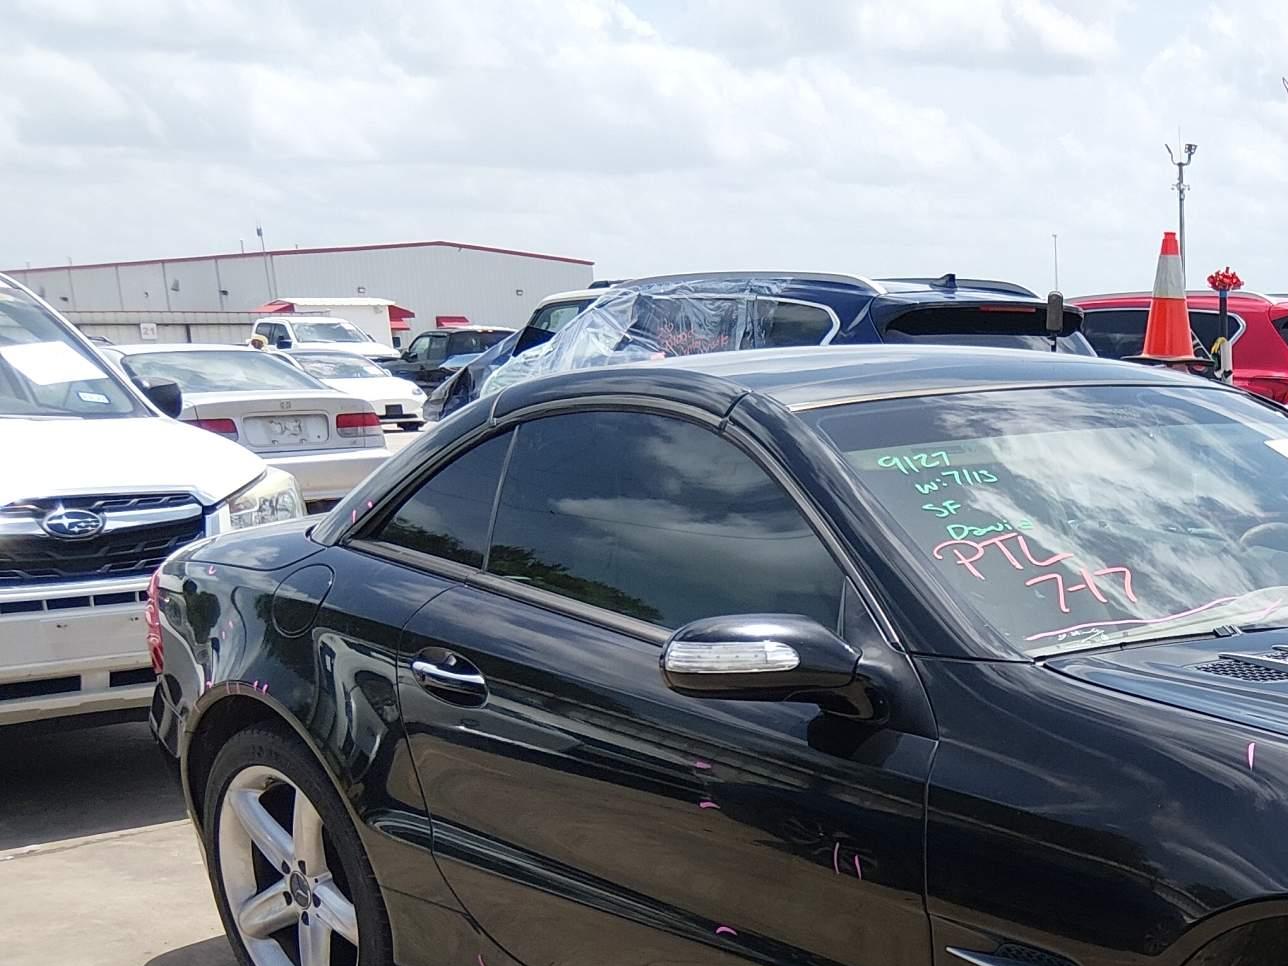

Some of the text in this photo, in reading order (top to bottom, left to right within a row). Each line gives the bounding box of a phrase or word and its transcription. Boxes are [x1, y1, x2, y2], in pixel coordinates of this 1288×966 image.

[143, 328, 155, 336] 21
[921, 500, 961, 518] SF
[933, 532, 1073, 581] PTL
